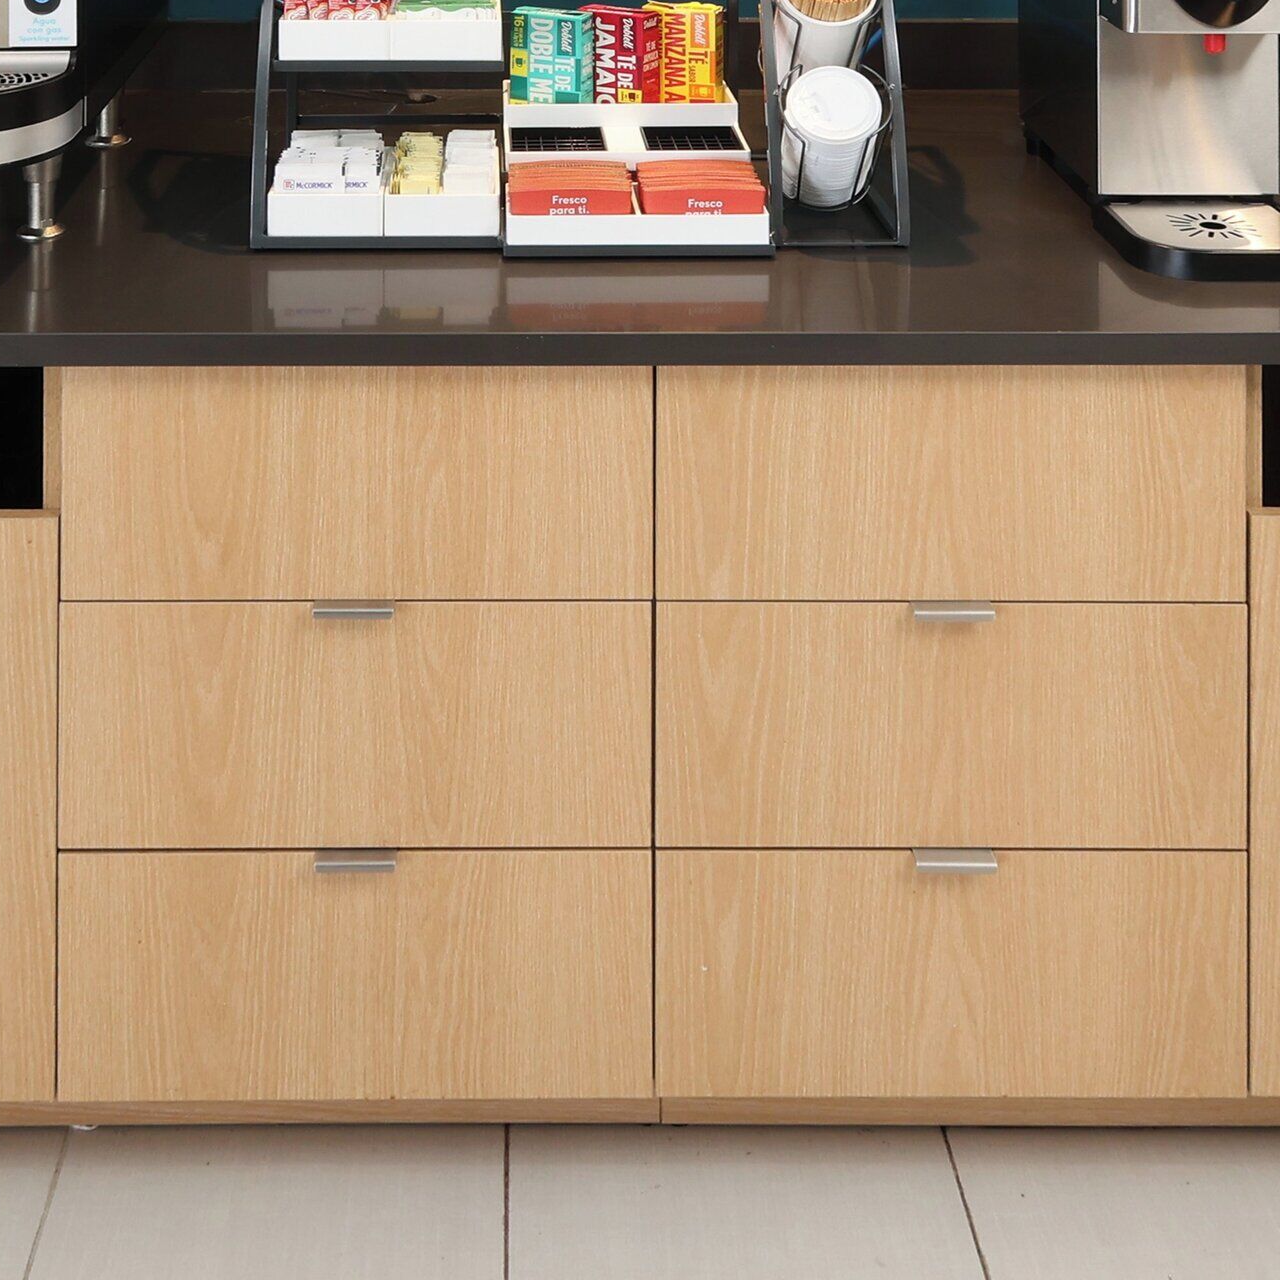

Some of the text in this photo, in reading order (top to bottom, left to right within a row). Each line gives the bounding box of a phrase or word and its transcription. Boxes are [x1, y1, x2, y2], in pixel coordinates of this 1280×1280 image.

[32, 17, 56, 26] Agua
[514, 15, 525, 27] 16
[47, 27, 62, 36] gas
[530, 18, 554, 74] DOBLE
[664, 13, 687, 88] MANZANA
[617, 55, 637, 70] TÉ
[688, 50, 708, 65] TÉ
[554, 75, 572, 92] DE
[617, 73, 634, 89] DE
[552, 195, 587, 205] Fresco
[688, 199, 723, 208] Fresco
[549, 205, 590, 216] para ti.
